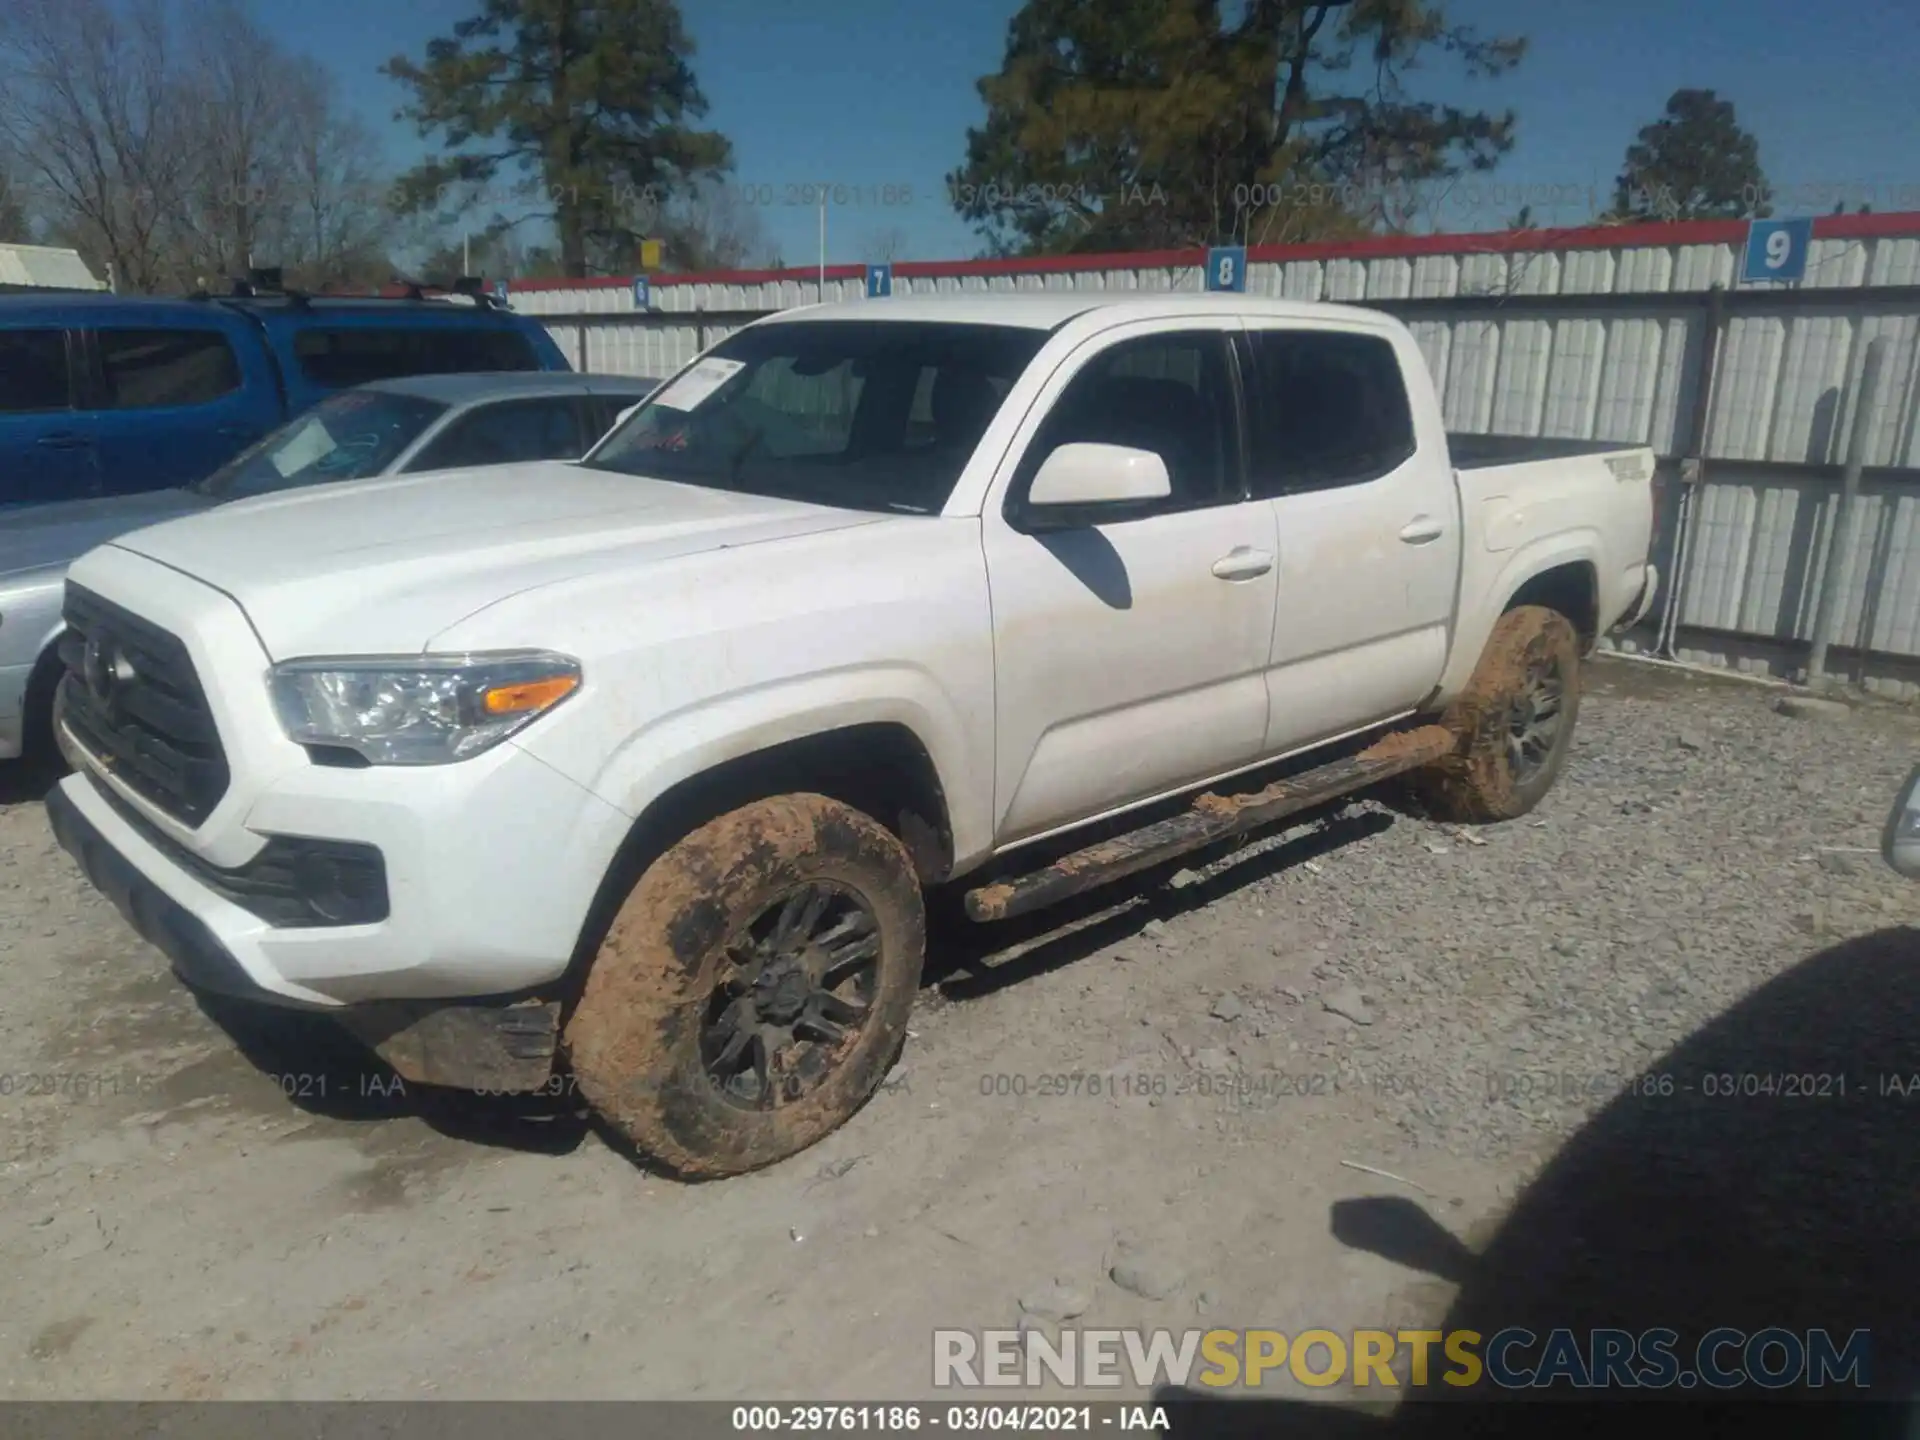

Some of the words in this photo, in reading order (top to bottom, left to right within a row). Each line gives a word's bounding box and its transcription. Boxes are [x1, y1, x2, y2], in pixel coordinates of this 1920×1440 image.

[1765, 230, 1790, 269] 9
[874, 270, 884, 293] 7
[1219, 256, 1233, 286] 8
